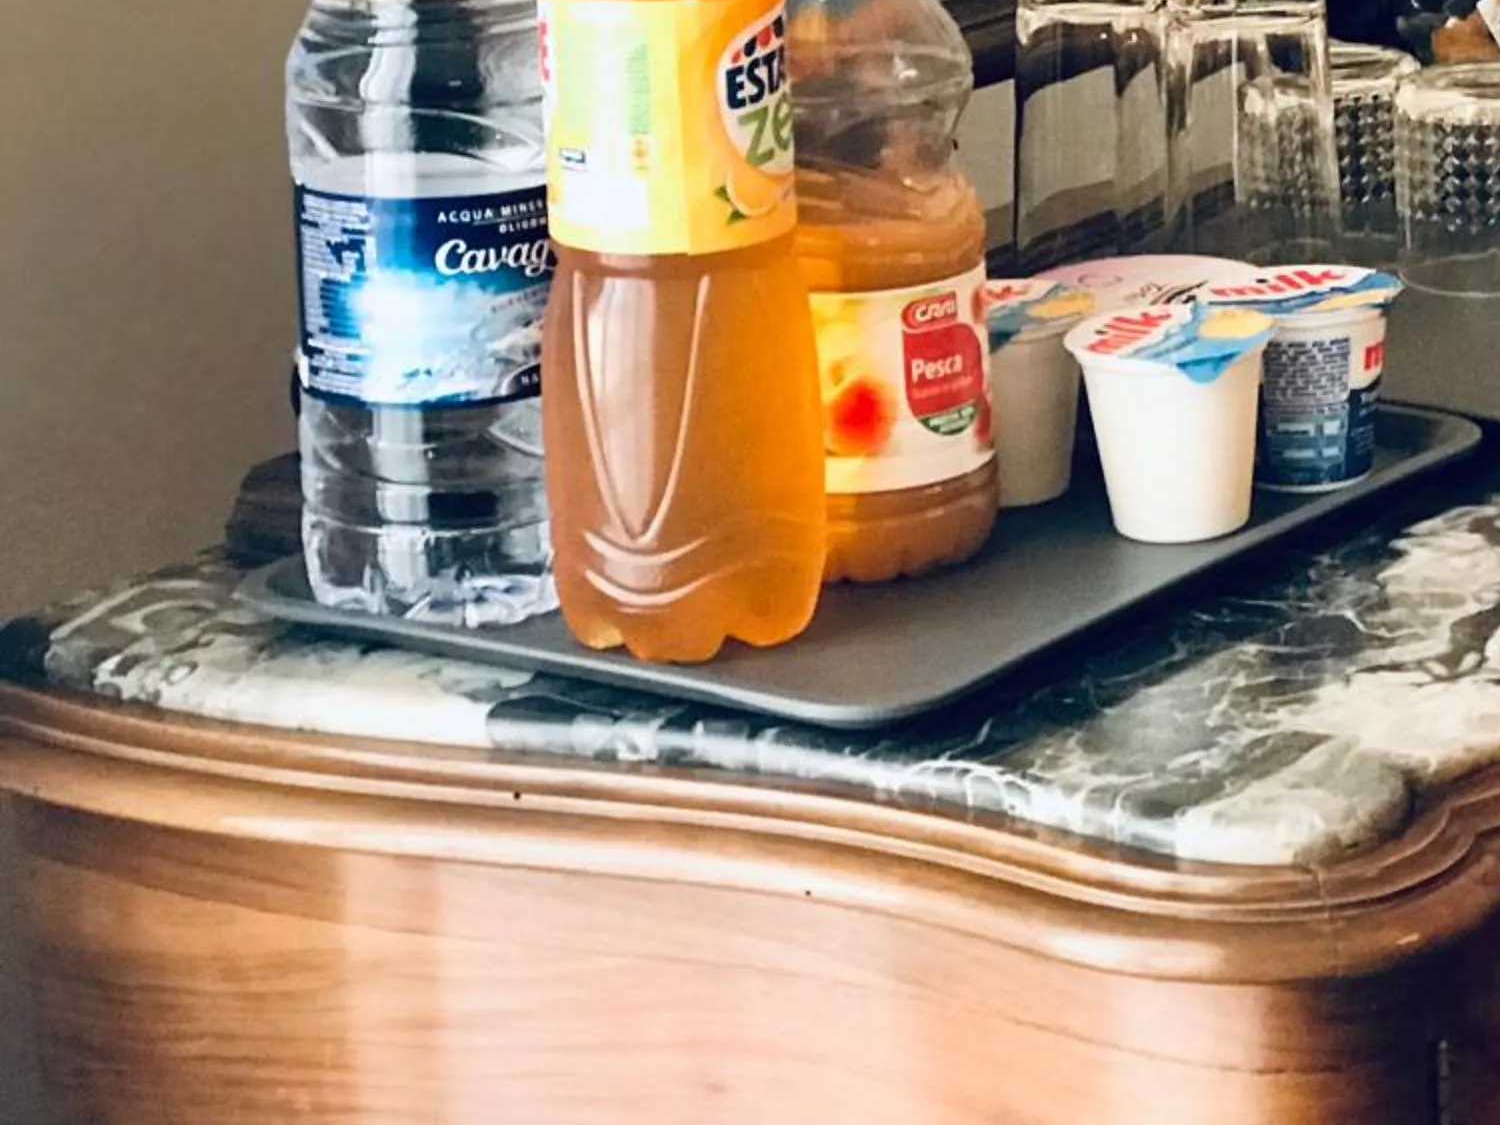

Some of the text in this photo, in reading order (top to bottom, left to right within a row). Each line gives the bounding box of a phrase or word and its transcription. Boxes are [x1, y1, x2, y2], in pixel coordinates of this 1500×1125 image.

[437, 208, 494, 224] ACQUA
[1211, 270, 1345, 297] milk
[1086, 312, 1171, 354] milk
[911, 354, 964, 383] Pesca
